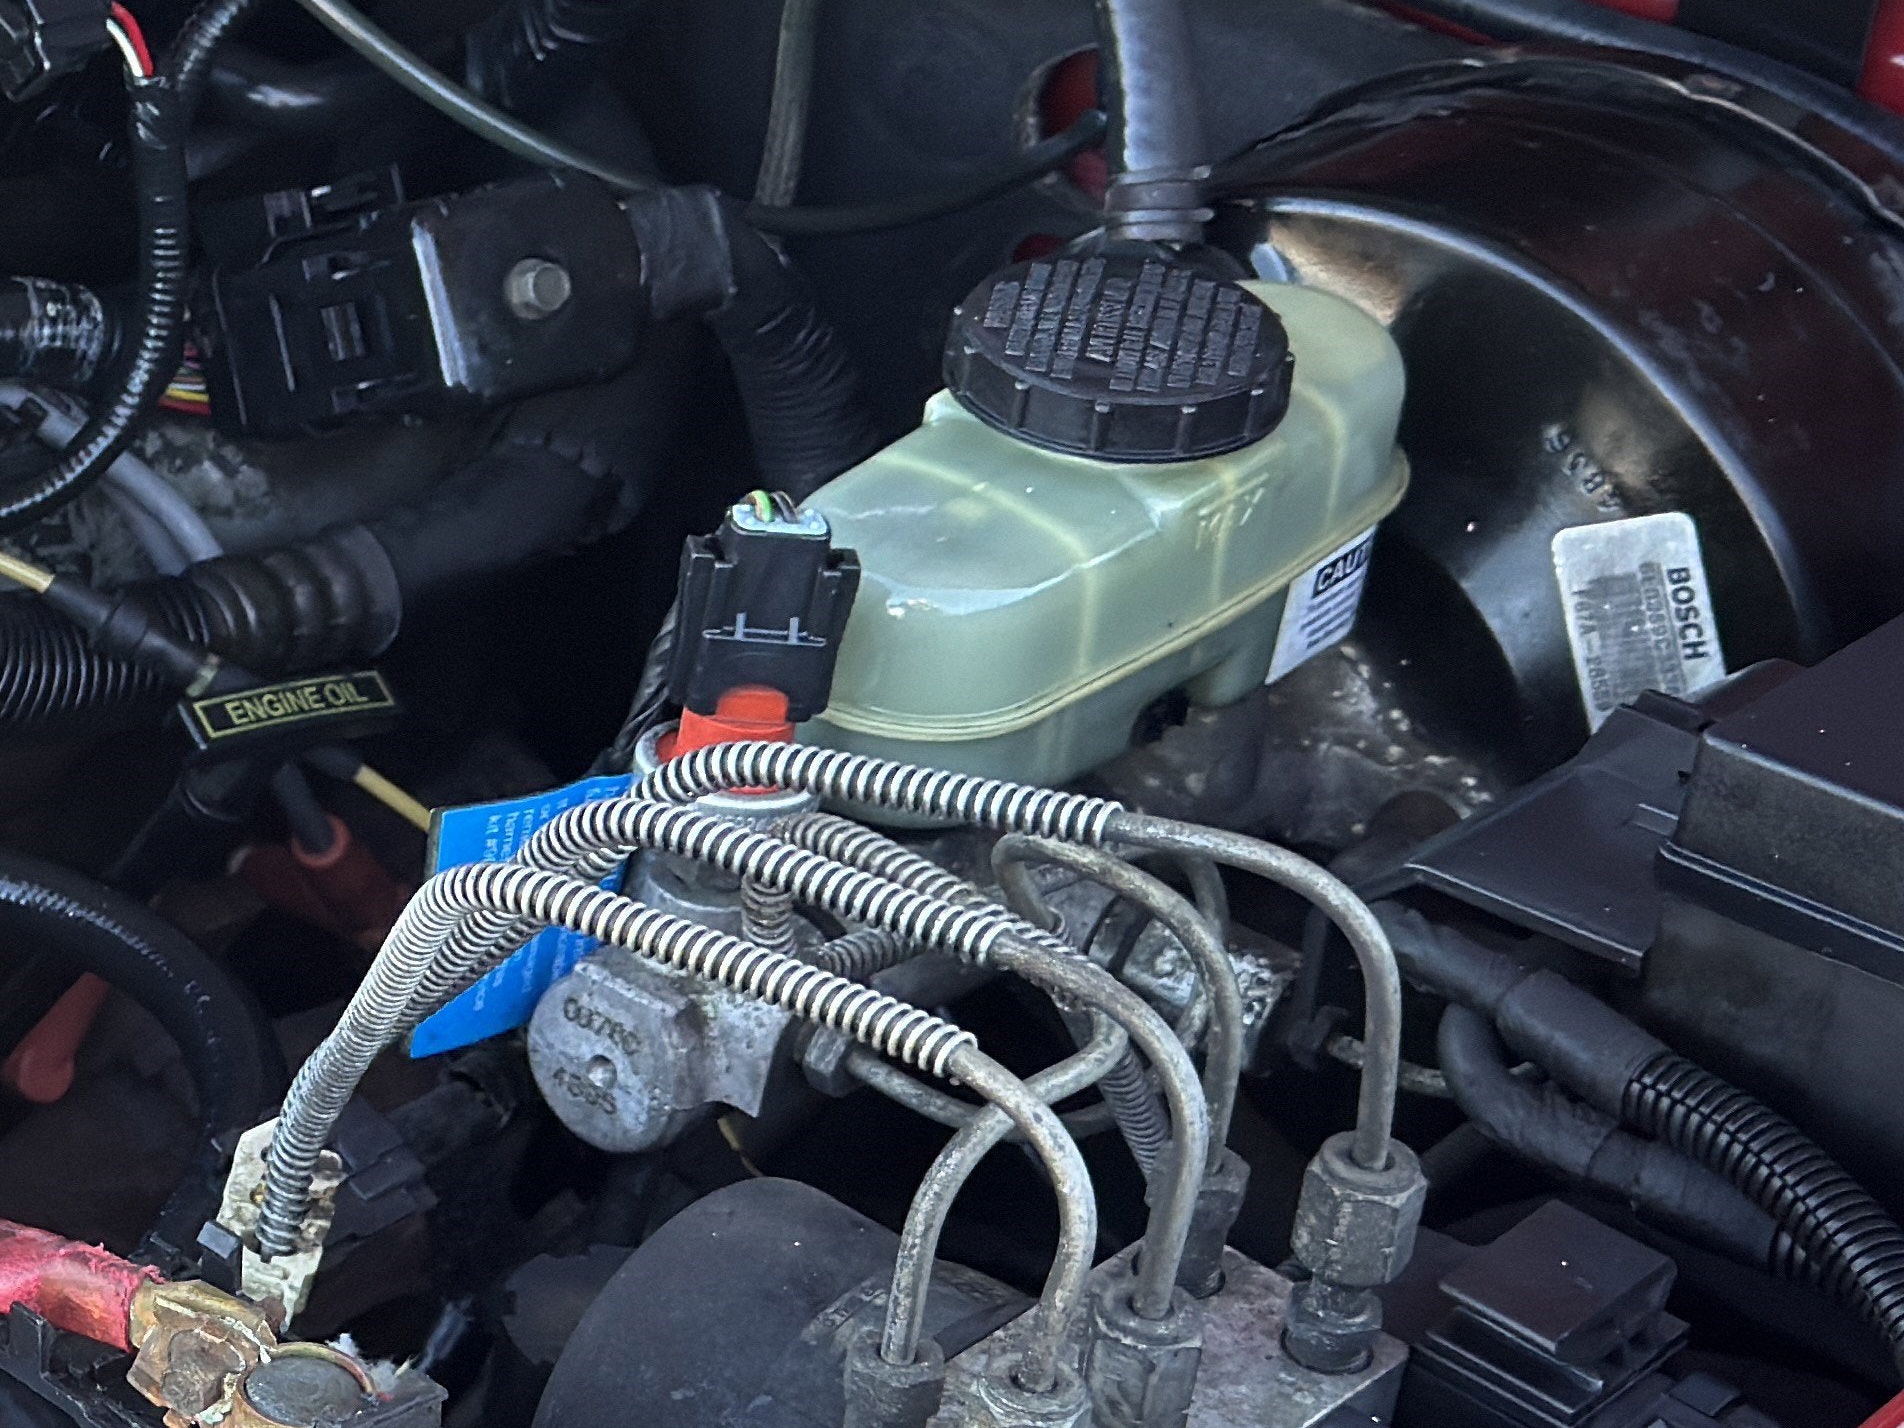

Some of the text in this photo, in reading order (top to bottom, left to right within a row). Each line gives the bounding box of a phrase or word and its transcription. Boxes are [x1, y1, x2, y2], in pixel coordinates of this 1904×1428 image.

[1666, 566, 1710, 661] BOSCH
[225, 682, 369, 725] ENGINE OIL
